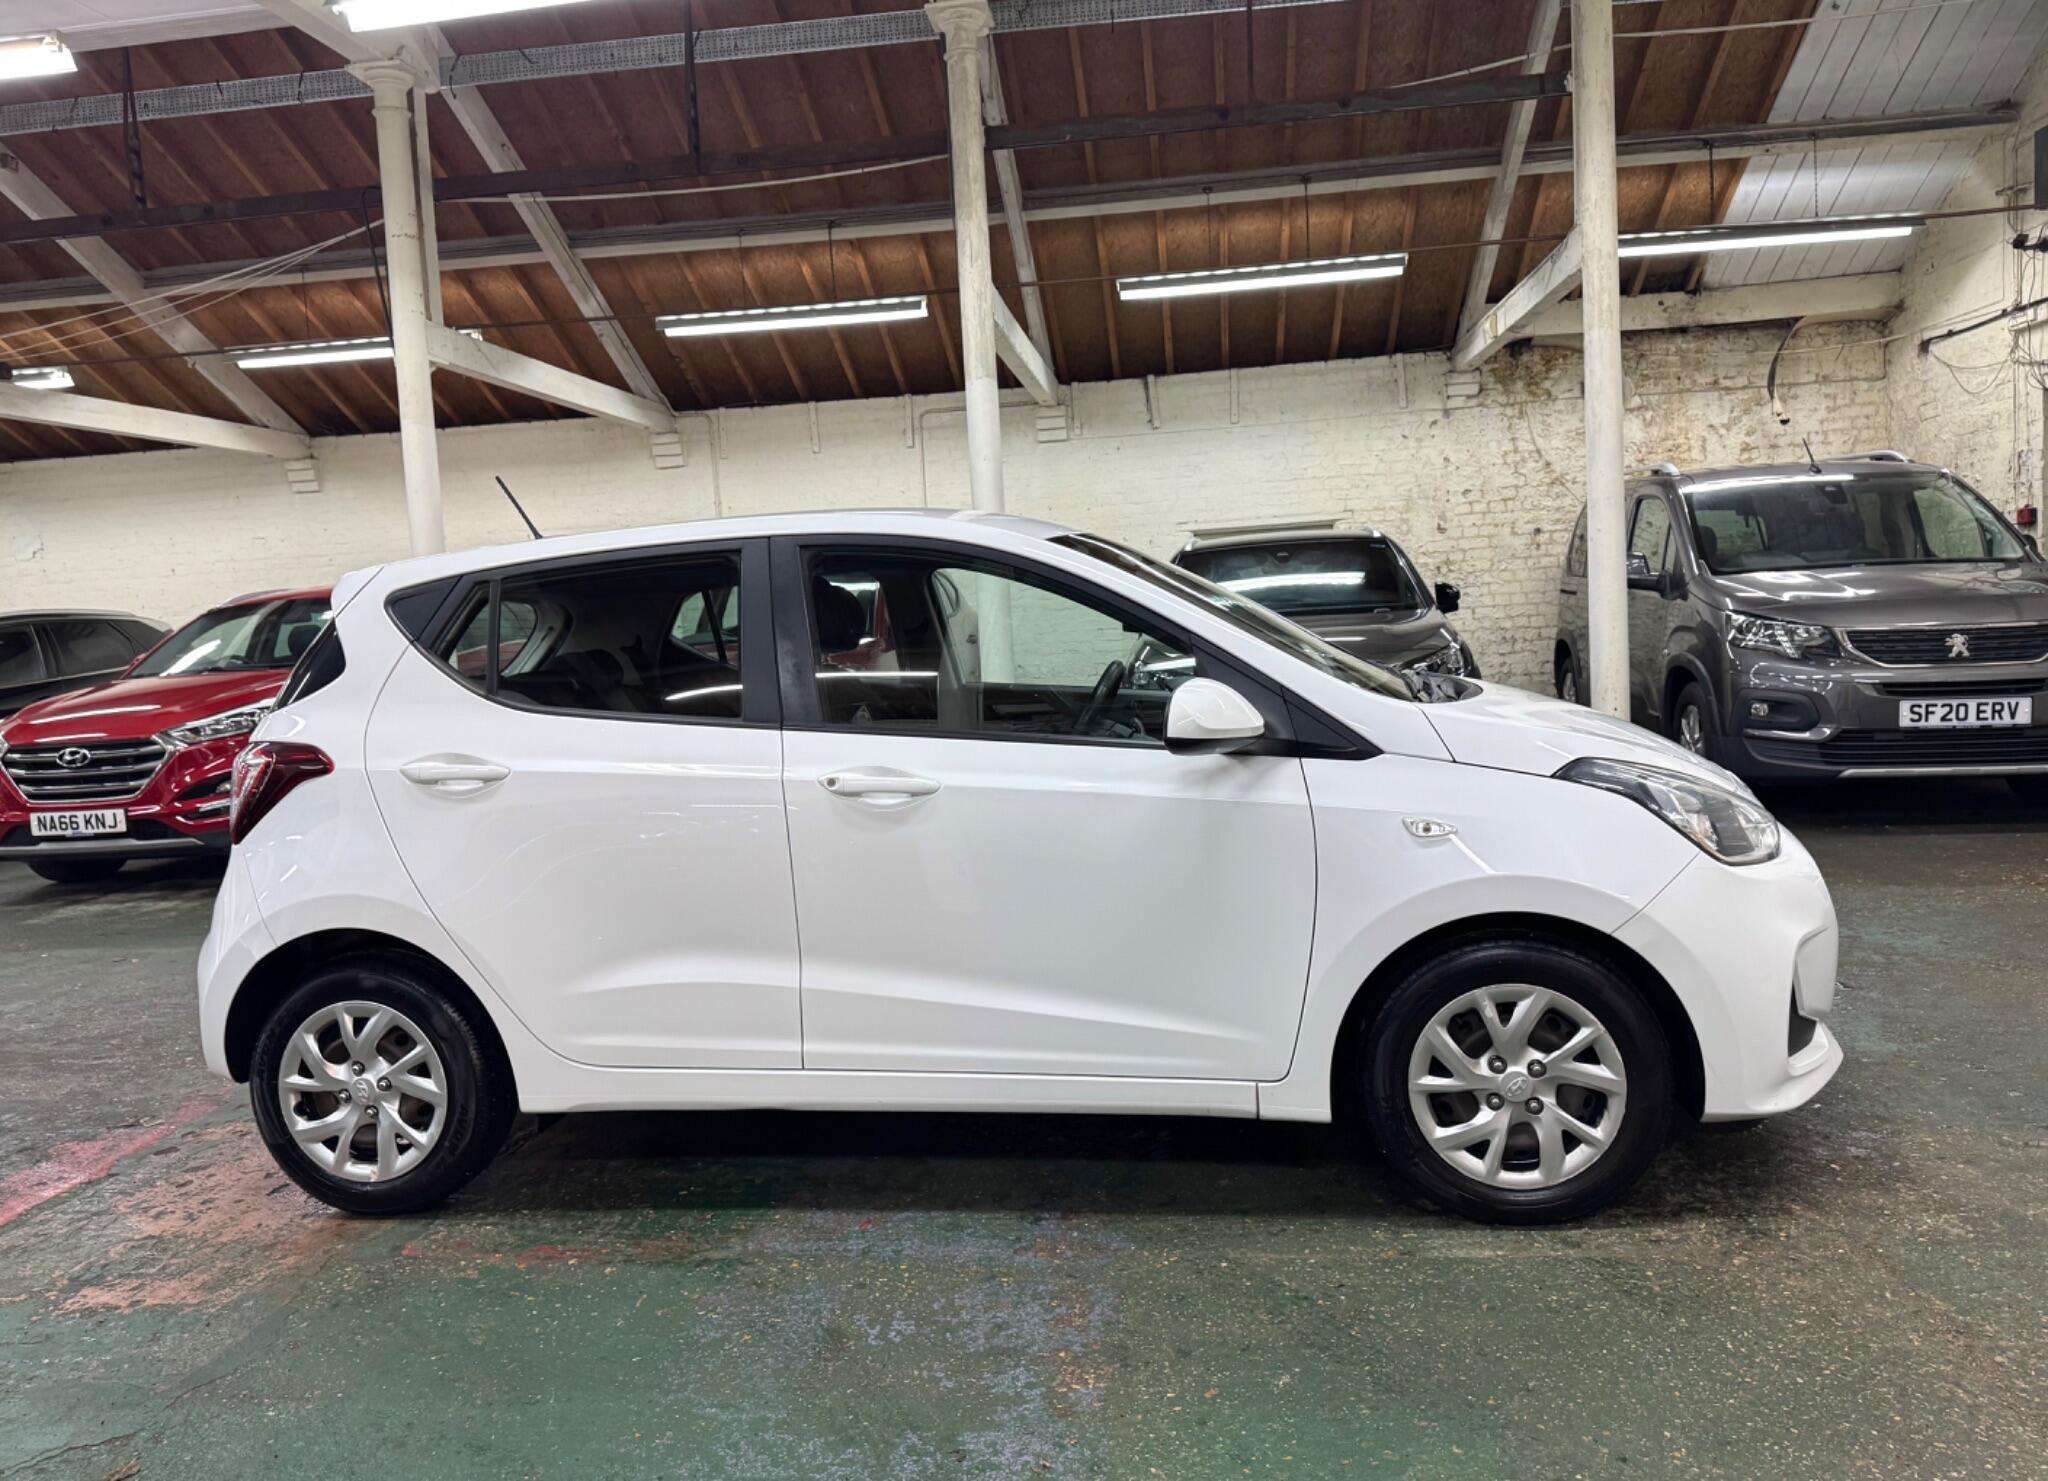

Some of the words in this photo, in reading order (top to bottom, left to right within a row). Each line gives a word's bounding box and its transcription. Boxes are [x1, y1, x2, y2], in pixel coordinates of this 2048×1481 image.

[1909, 702, 1969, 723] SF20
[1976, 701, 2020, 721] ERV
[37, 814, 80, 832] NA66
[83, 812, 118, 831] KNJ
